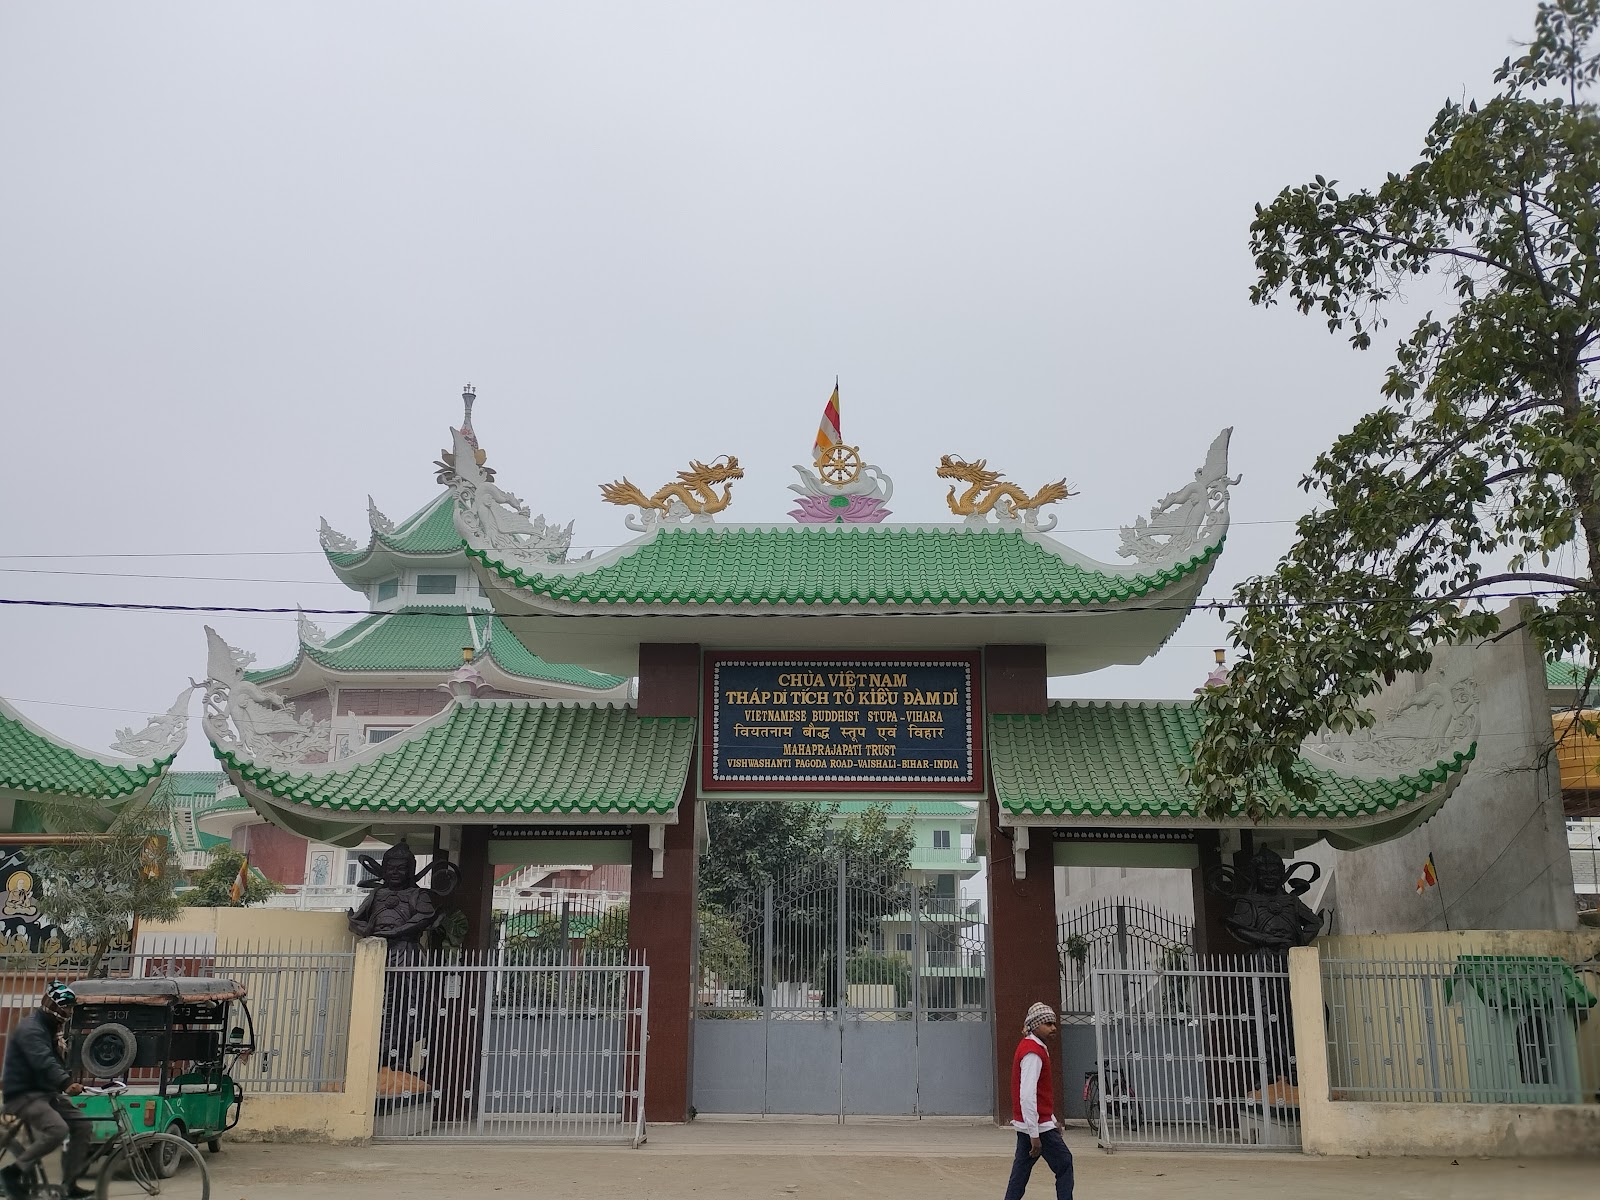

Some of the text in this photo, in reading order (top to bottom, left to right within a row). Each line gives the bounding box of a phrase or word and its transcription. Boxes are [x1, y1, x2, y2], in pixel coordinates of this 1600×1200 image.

[778, 670, 825, 687] CHÙA
[869, 673, 907, 687] NAM
[725, 687, 771, 705] THÁP
[790, 687, 829, 705] TÍCH
[903, 688, 940, 705] ĐÀM
[744, 710, 807, 722] VIETNAMESE
[812, 710, 860, 722] BUDDHIST
[868, 711, 898, 722] STUPA
[733, 722, 945, 743] वियतनाम बौद्ध स्तूप एवं विहार
[783, 743, 896, 756] MAHAPRAJAPATI TRUST
[727, 759, 791, 768] VISHWASHANTI
[795, 759, 827, 768] PAGODA
